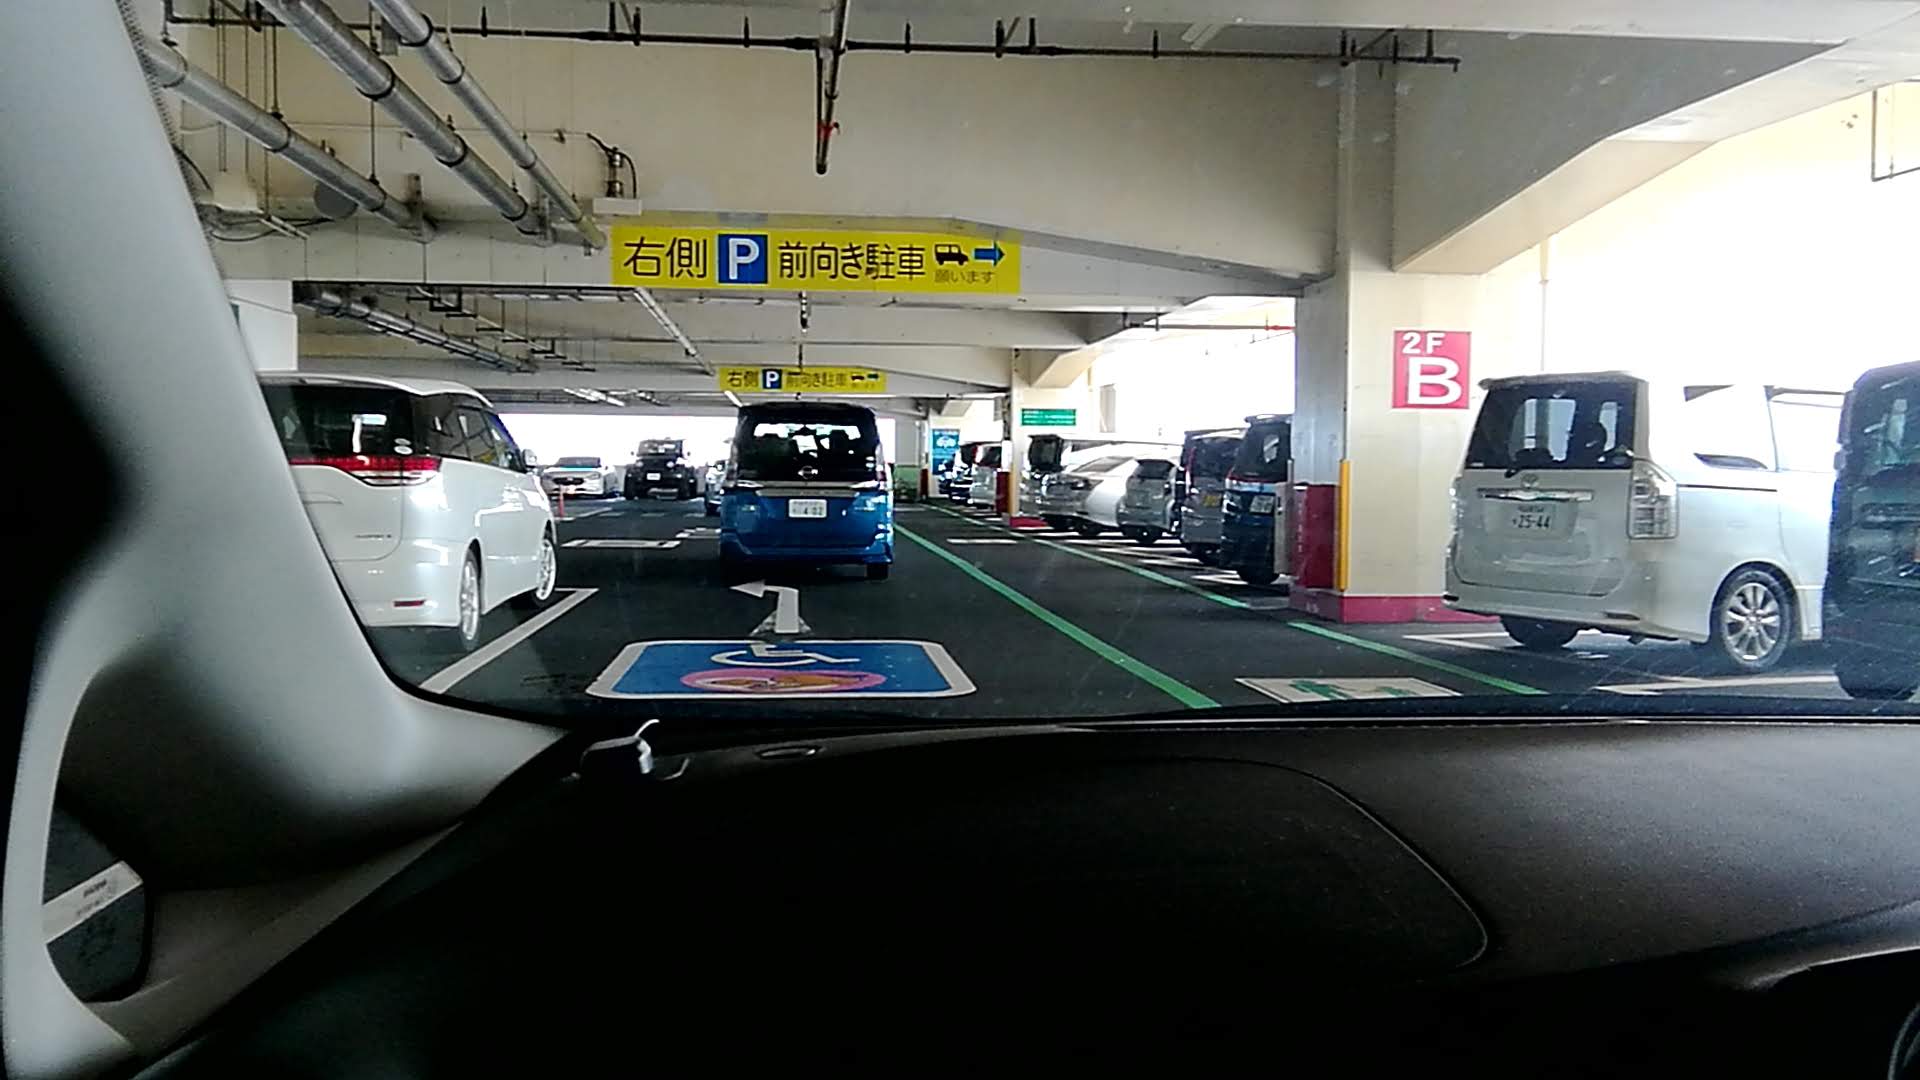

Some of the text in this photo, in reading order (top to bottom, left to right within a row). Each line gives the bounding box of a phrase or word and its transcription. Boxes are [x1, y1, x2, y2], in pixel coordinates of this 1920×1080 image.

[623, 236, 926, 281] 右側 P 前向き駐車
[934, 269, 996, 284] 願います
[1402, 331, 1447, 355] 2F
[765, 370, 777, 388] P
[1407, 356, 1463, 405] B
